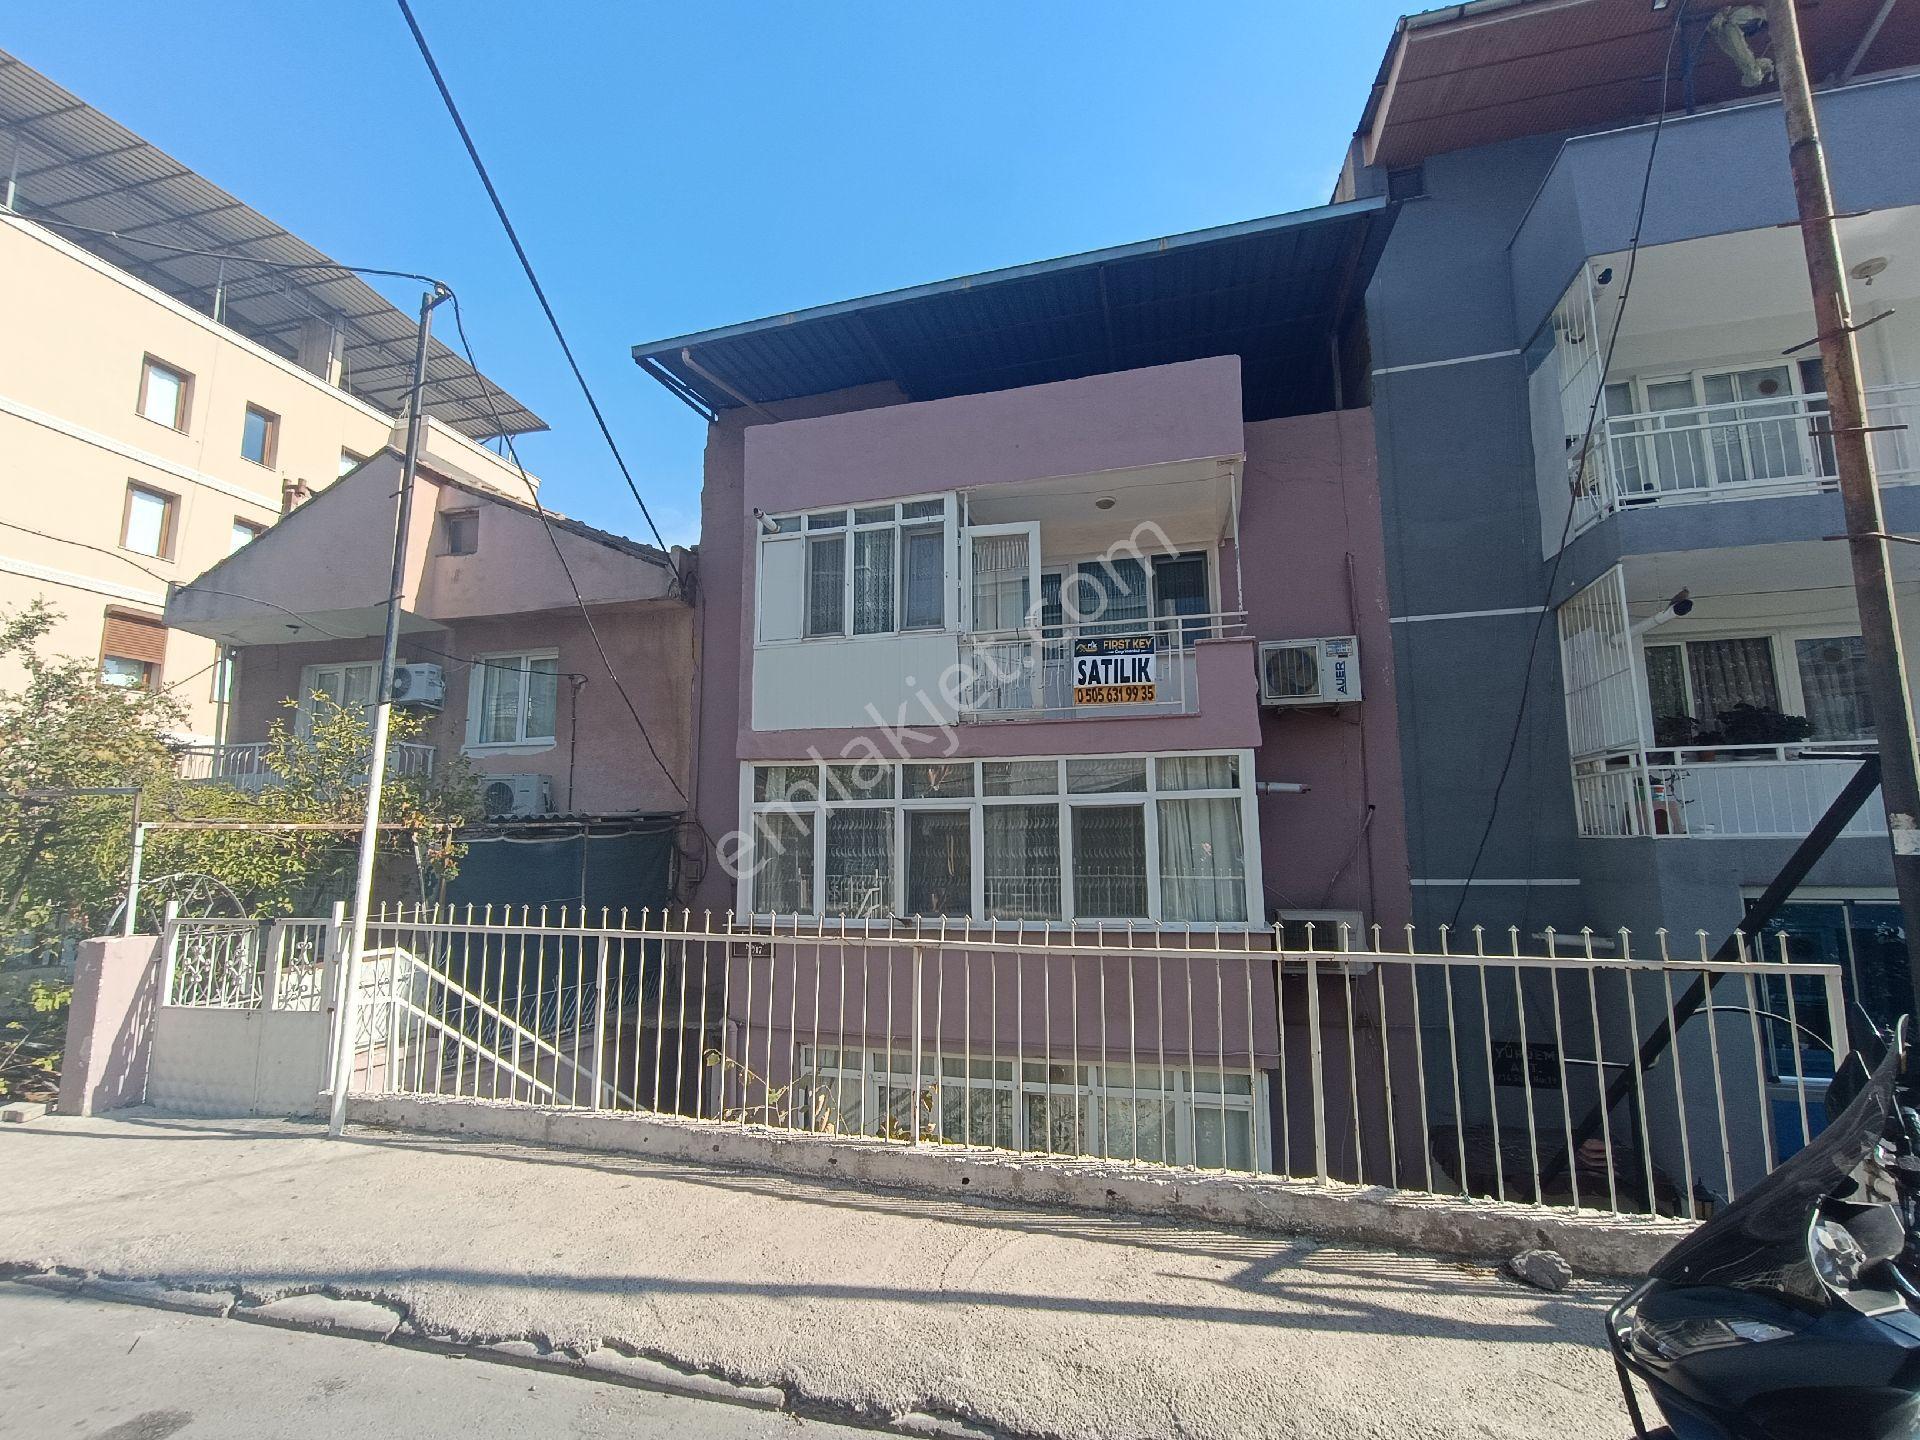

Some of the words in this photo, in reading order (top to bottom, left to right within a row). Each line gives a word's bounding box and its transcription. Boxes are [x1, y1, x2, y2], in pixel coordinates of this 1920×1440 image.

[1103, 639, 1130, 650] FIRST
[1132, 638, 1151, 649] KEY
[1077, 657, 1152, 686] SATILIK
[1335, 660, 1346, 694] AUER
[1077, 688, 1084, 703] 0
[1085, 687, 1105, 703] 505
[1106, 687, 1123, 702] 631
[1125, 686, 1139, 702] 99
[1141, 685, 1154, 701] 35
